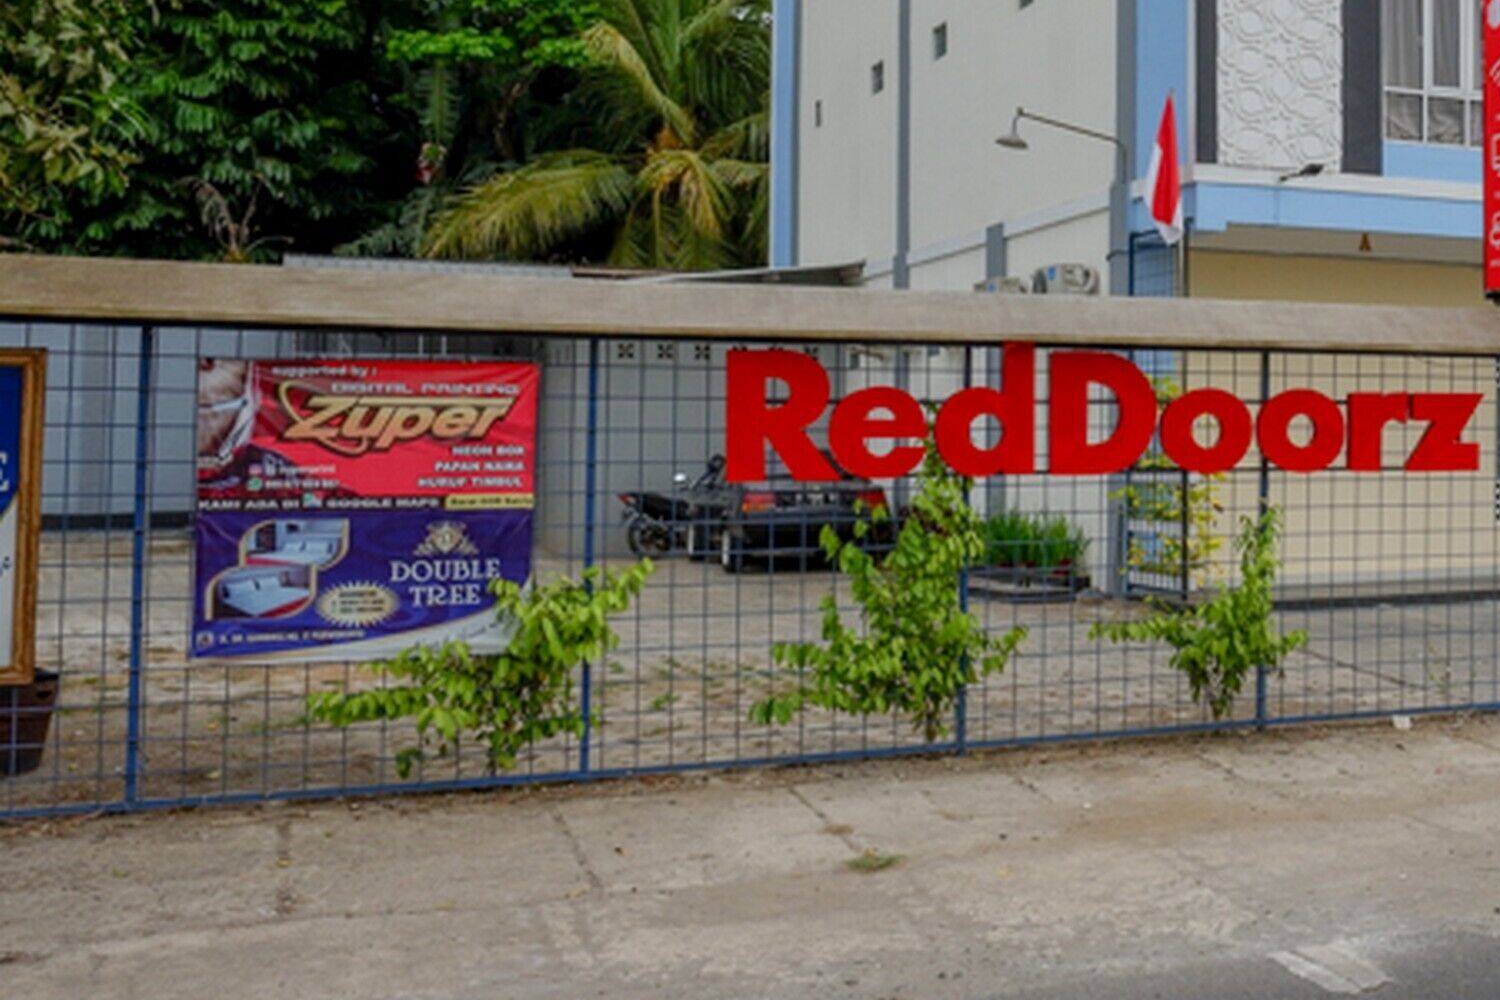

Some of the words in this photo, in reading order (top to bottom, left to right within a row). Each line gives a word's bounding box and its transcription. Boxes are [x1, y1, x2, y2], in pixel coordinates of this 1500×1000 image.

[279, 382, 515, 454] Zuper
[724, 341, 1484, 483] RedDoorz
[390, 557, 502, 583] DOUBLE
[409, 584, 482, 608] TREE
